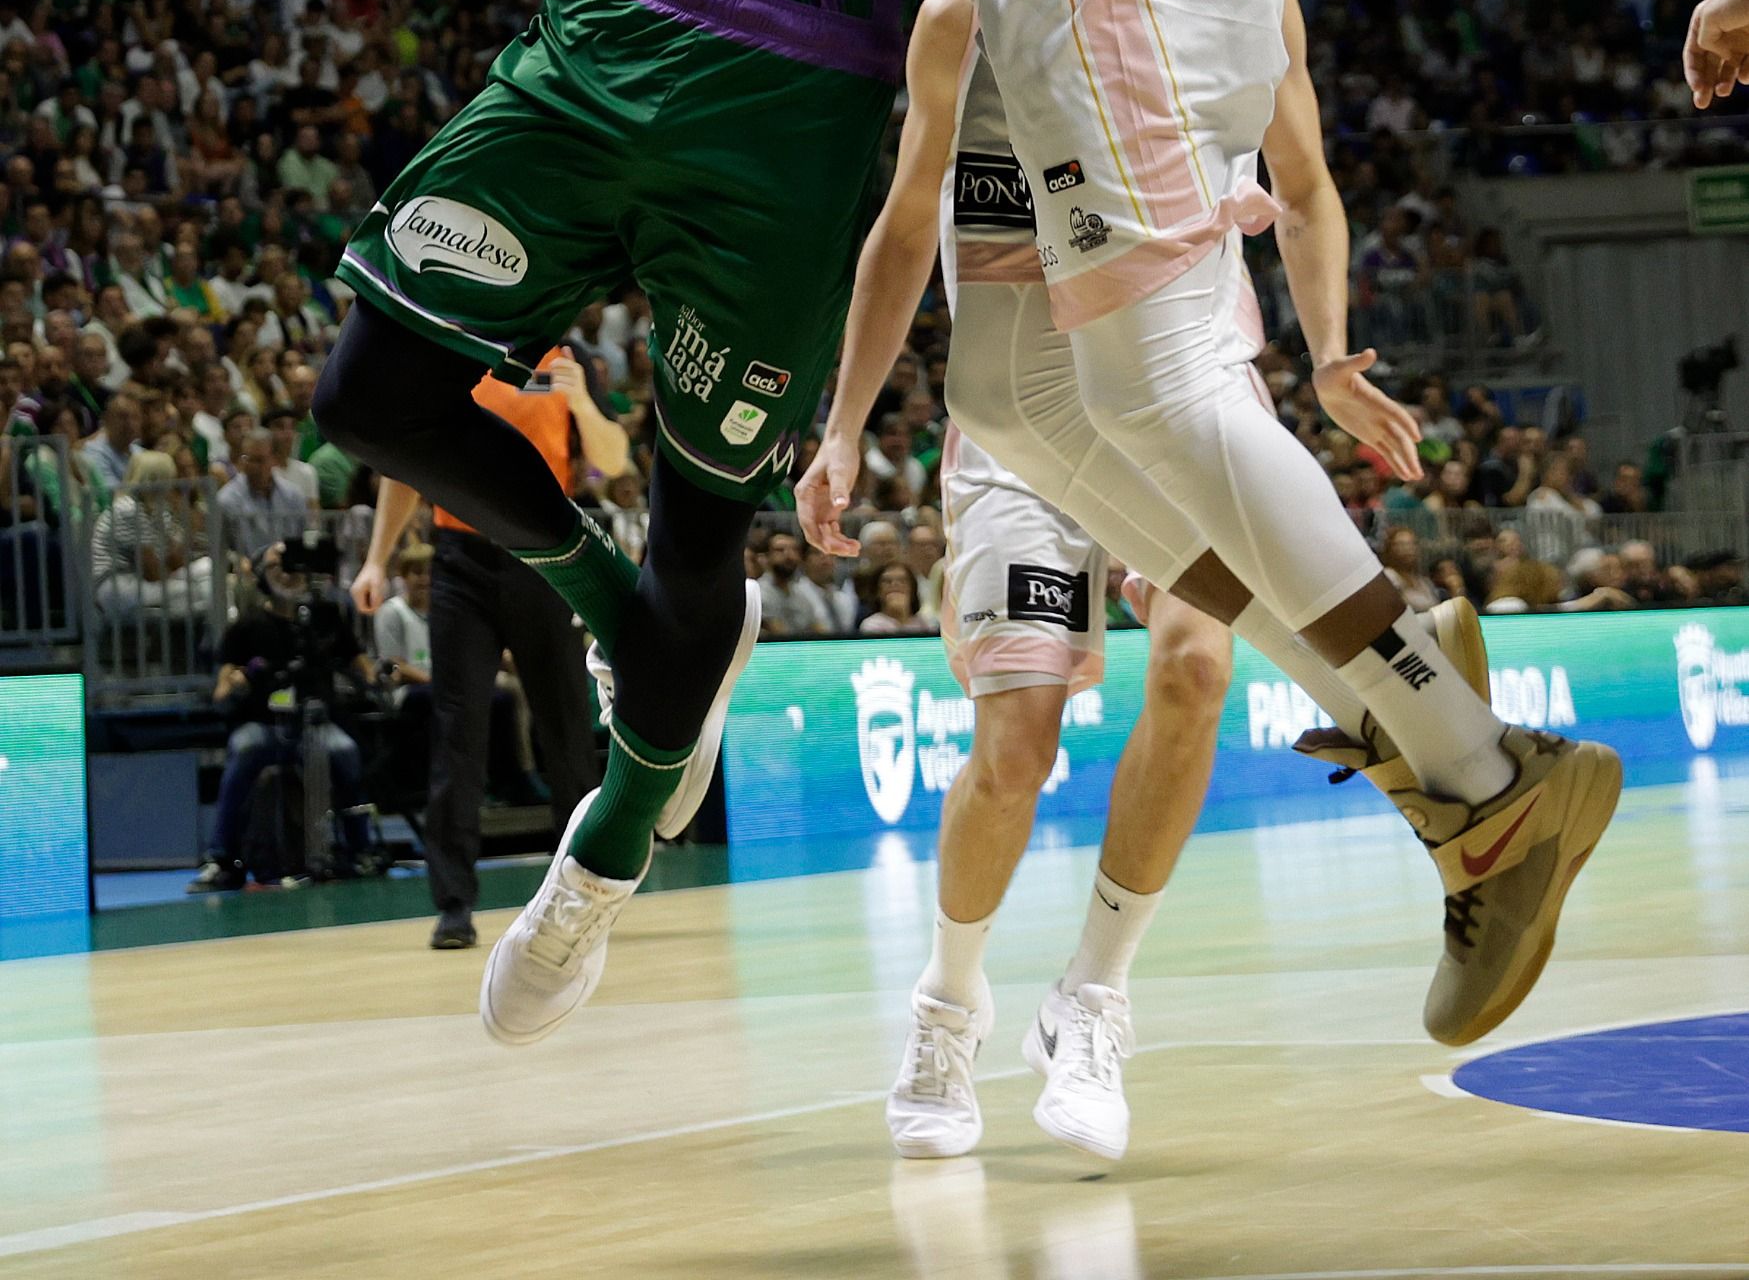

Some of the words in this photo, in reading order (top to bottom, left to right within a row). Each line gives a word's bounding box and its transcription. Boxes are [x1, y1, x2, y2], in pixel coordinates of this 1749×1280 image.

[1049, 172, 1076, 192] acb
[392, 199, 521, 273] famadesa
[749, 373, 778, 392] acb
[1391, 651, 1437, 691] NIKE
